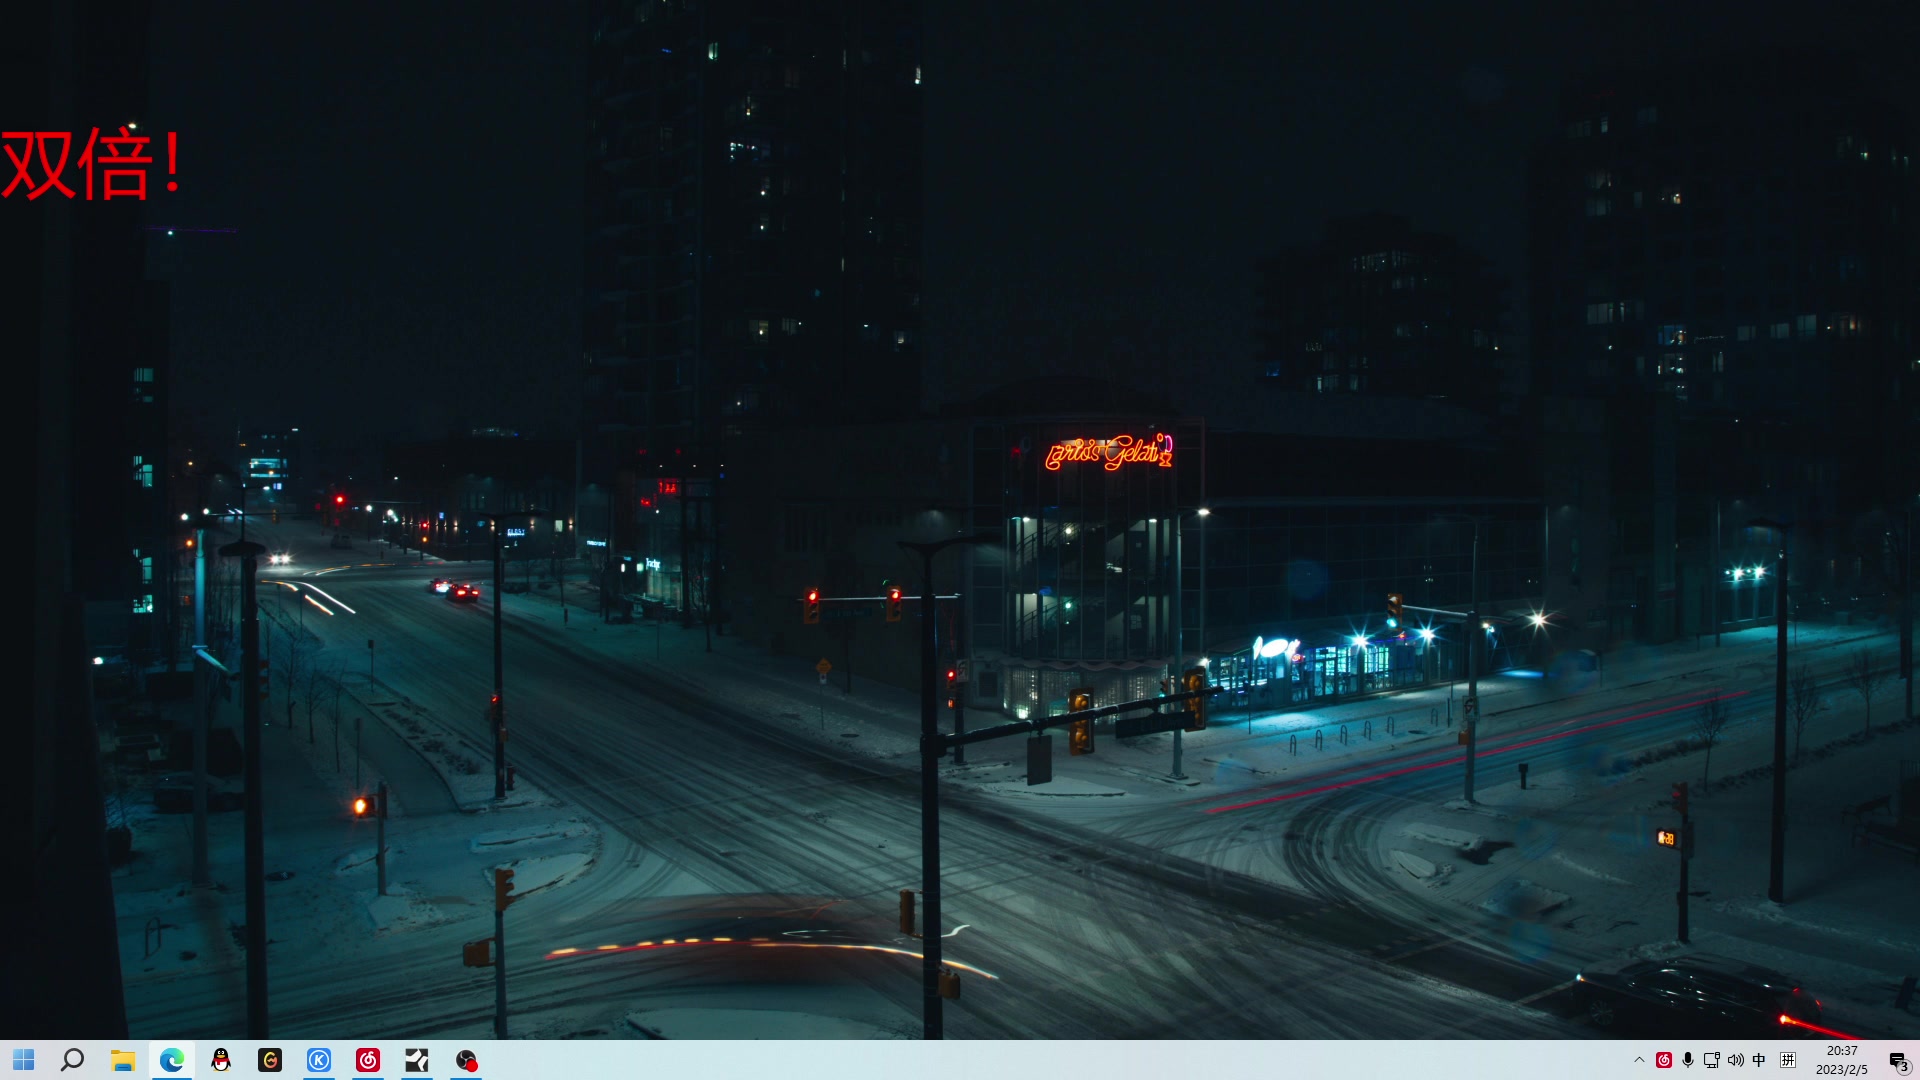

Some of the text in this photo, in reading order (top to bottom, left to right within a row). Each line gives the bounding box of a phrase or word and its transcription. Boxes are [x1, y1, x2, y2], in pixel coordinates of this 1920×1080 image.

[1827, 1046, 1858, 1056] 20:37
[1752, 1053, 1765, 1068] 中
[1782, 1054, 1794, 1067] 拼
[1816, 1064, 1868, 1076] 2023/2/5
[1901, 1062, 1908, 1072] 3
